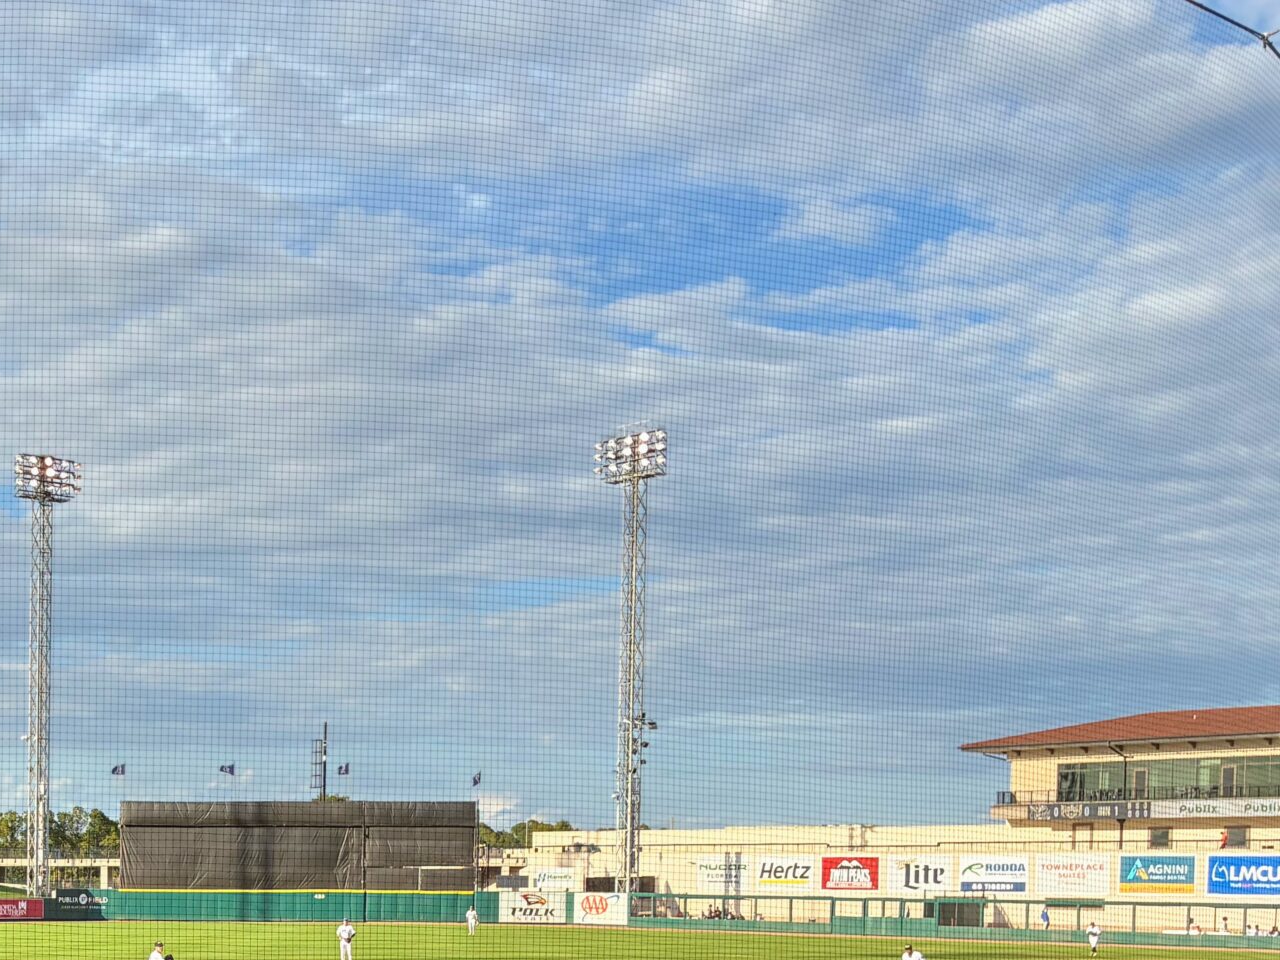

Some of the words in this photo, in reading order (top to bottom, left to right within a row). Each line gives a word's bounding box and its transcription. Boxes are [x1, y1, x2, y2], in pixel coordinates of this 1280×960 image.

[1179, 804, 1217, 814] Publix
[699, 863, 747, 871] NUCOR
[759, 862, 812, 879] Hertz
[985, 863, 1026, 872] RODDA
[1041, 863, 1105, 872] TOWNEPLACE
[1148, 864, 1188, 875] AGNINI
[830, 868, 849, 882] TWIN
[849, 868, 871, 882] PEAKS
[904, 863, 945, 890] Lite
[1230, 865, 1280, 882] LMCU
[58, 896, 78, 904] PUBLIX
[88, 896, 109, 904] FIELD
[511, 907, 555, 917] POLK
